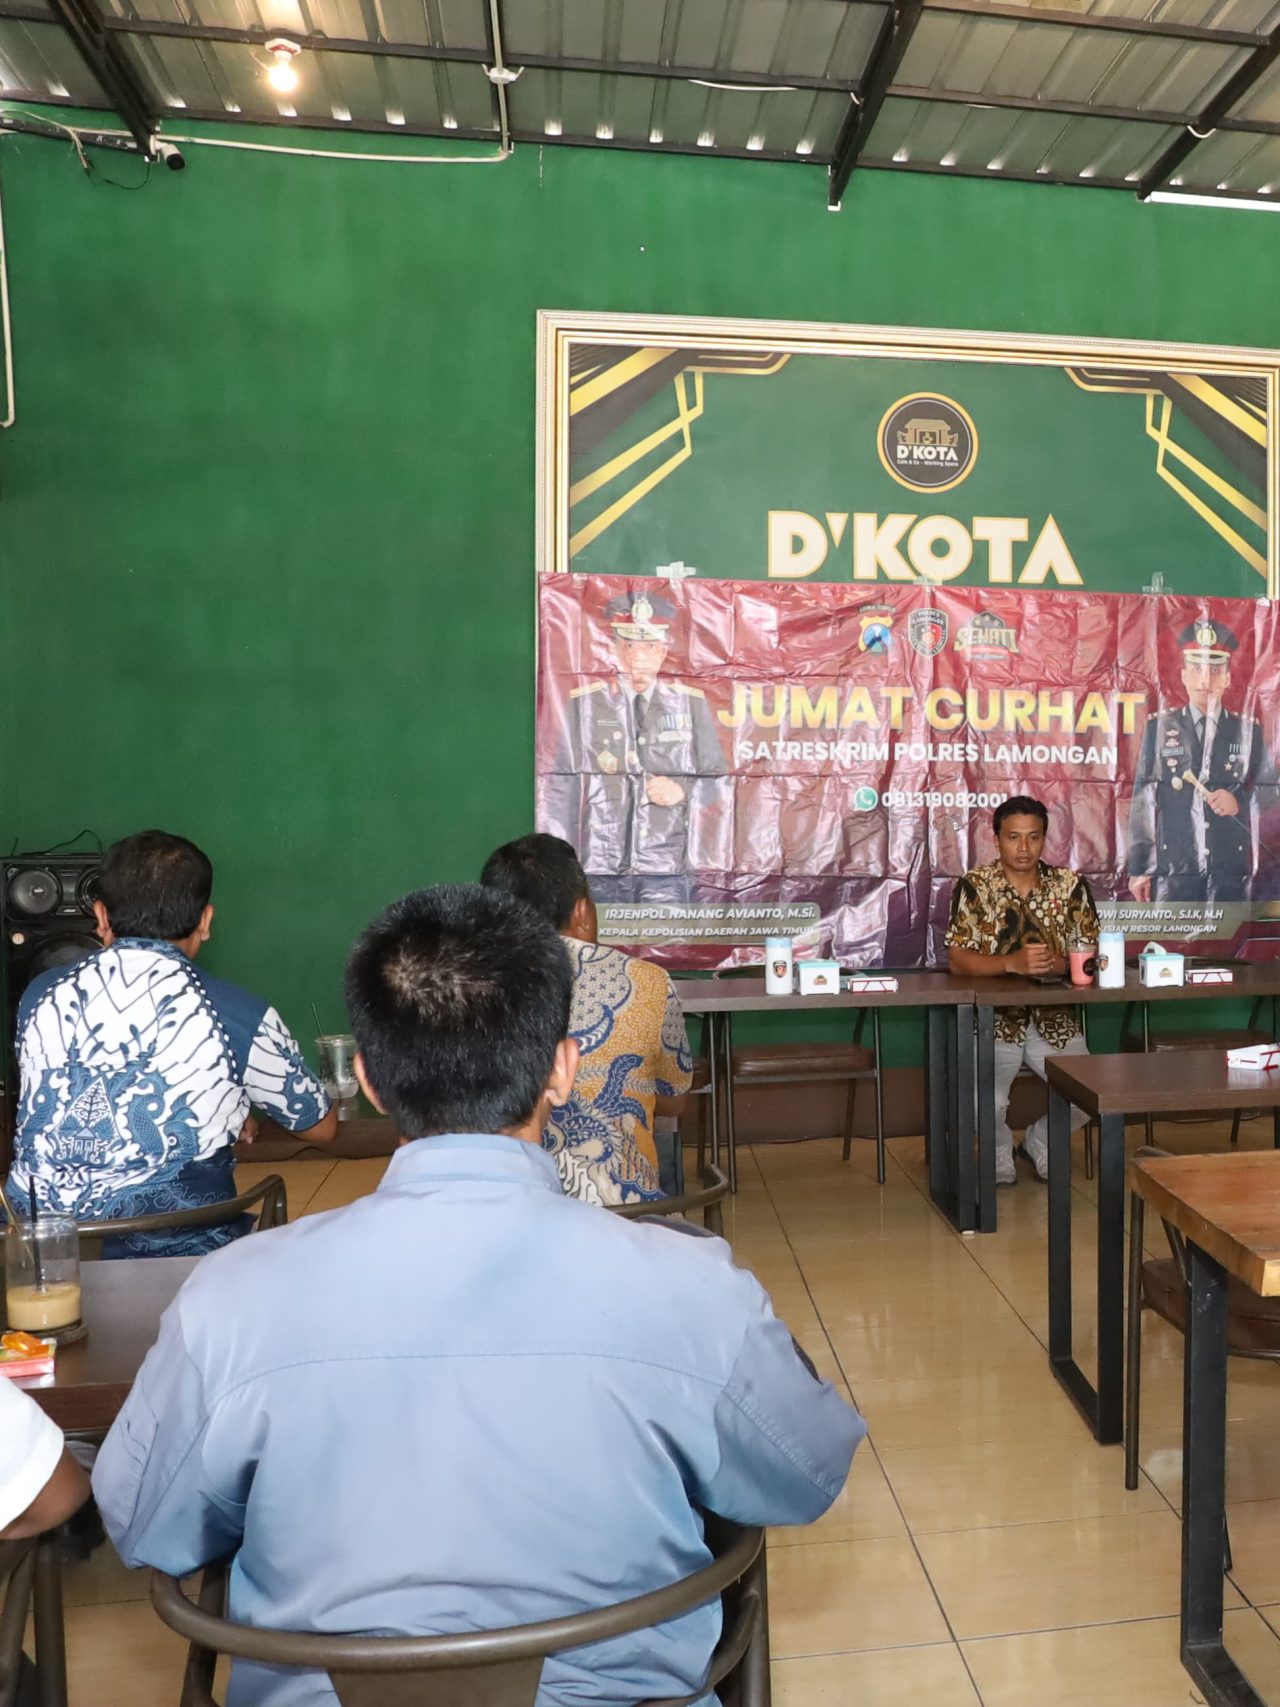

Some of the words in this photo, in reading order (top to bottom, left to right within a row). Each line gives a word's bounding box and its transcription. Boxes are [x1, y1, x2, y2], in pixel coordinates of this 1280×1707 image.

[896, 445, 958, 461] D'KOTA
[768, 510, 1084, 585] D'KOTA
[717, 684, 912, 729] JUMAT
[925, 687, 1146, 735] CURHAT
[740, 741, 889, 761] SATRESKRIM
[894, 742, 978, 762] POLRES
[984, 743, 1118, 765] LAMONGAN
[605, 908, 666, 919] IRJENPOL
[669, 908, 723, 919] NANANG
[726, 908, 785, 921] AVIANTO,
[1204, 908, 1224, 919] M.H
[598, 927, 639, 937] KEPALA
[641, 927, 702, 937] KEPOLISIAN
[704, 927, 748, 936] DAERAH
[748, 927, 779, 936] JAWA
[1130, 925, 1161, 934] RESOR
[1163, 924, 1217, 933] LAMONGAN
